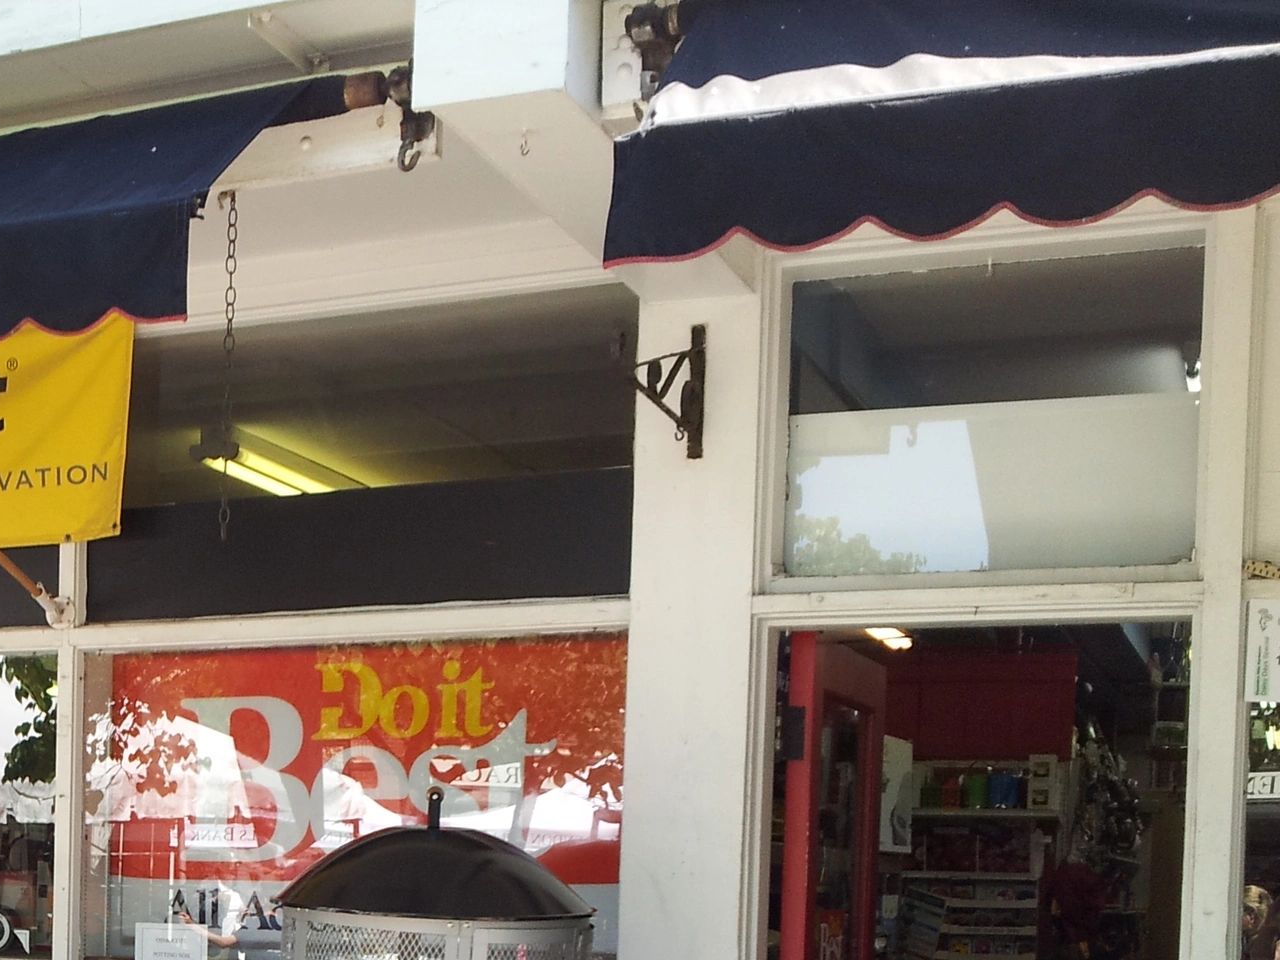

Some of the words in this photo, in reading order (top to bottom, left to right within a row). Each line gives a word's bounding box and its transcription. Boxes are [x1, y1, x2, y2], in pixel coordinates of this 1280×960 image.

[313, 660, 429, 741] Do
[435, 658, 497, 738] it
[181, 696, 558, 862] Best
